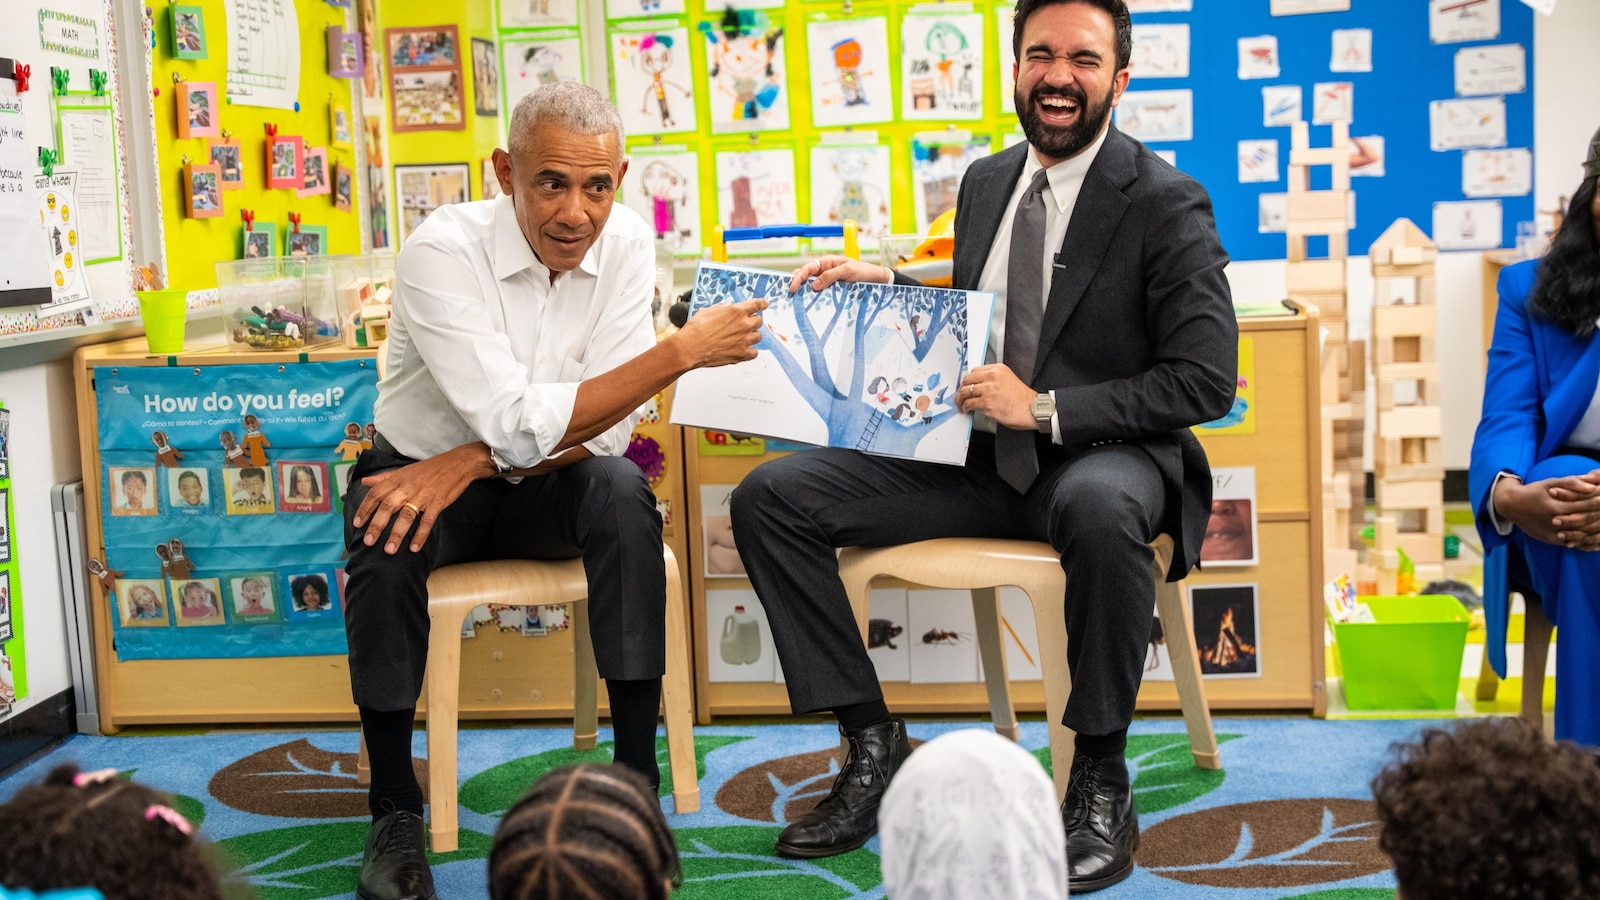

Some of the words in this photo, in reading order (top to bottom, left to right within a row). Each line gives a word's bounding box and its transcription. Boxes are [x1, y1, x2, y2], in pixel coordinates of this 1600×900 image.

[61, 27, 79, 41] MATH
[11, 128, 23, 140] line
[8, 182, 15, 193] is
[18, 184, 23, 193] a
[143, 394, 198, 413] How
[202, 391, 233, 411] do
[236, 394, 283, 416] you
[288, 386, 344, 409] feel?
[141, 420, 167, 429] ¿Cómo
[175, 419, 203, 427] sientes?
[207, 418, 241, 426] Comment
